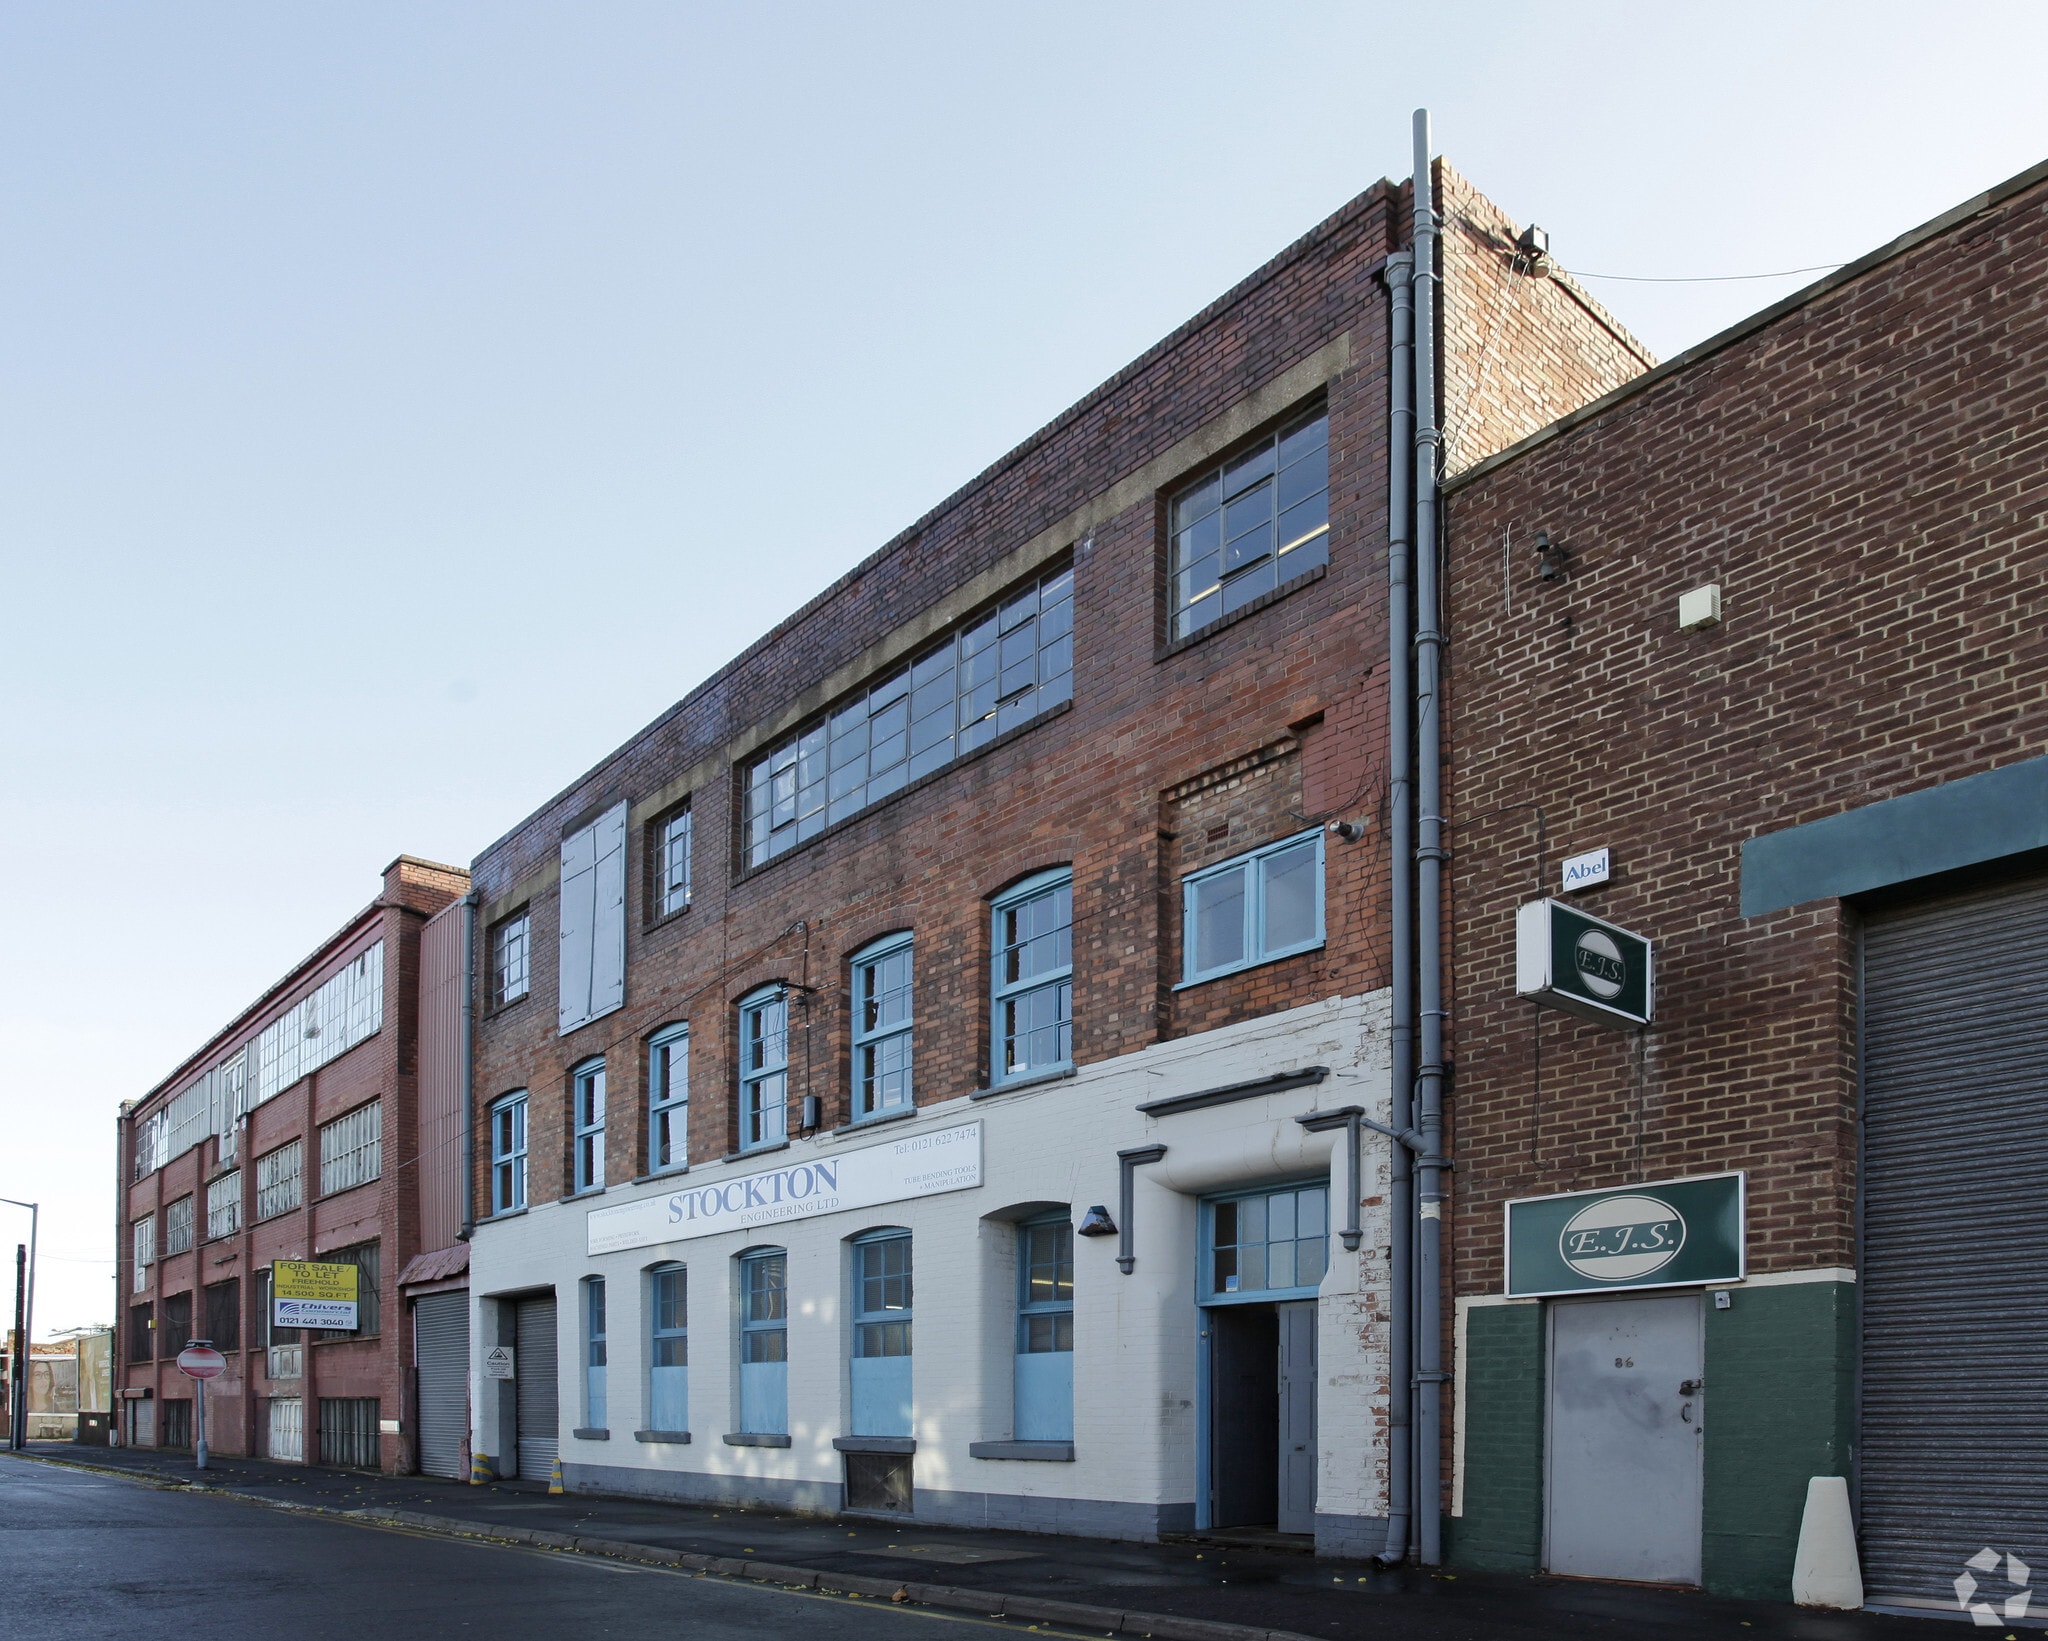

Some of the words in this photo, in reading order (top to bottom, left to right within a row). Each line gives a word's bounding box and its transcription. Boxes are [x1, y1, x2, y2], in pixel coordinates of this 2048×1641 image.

[1565, 857, 1606, 882] Abel
[1579, 950, 1622, 980] E.J.S.
[894, 1144, 910, 1155] Tel:
[911, 1138, 932, 1151] 0121
[935, 1133, 952, 1146] 622
[954, 1128, 976, 1142] 7474
[904, 1175, 921, 1185] TUBE
[922, 1169, 953, 1181] BENDING
[953, 1164, 977, 1175] TOOLS
[924, 1173, 977, 1189] MANIPULATION
[668, 1159, 840, 1224] STOCKTON
[740, 1201, 814, 1224] ENGINEERING
[816, 1197, 840, 1210] LTD
[1569, 1223, 1674, 1254] E.J.S.
[280, 1262, 306, 1270] FOR
[315, 1271, 339, 1279] LET
[292, 1278, 340, 1286] FREEHOLD
[301, 1302, 352, 1310] Chivers
[302, 1317, 317, 1325] 441
[320, 1318, 344, 1326] 3040
[1614, 1356, 1634, 1368] 86
